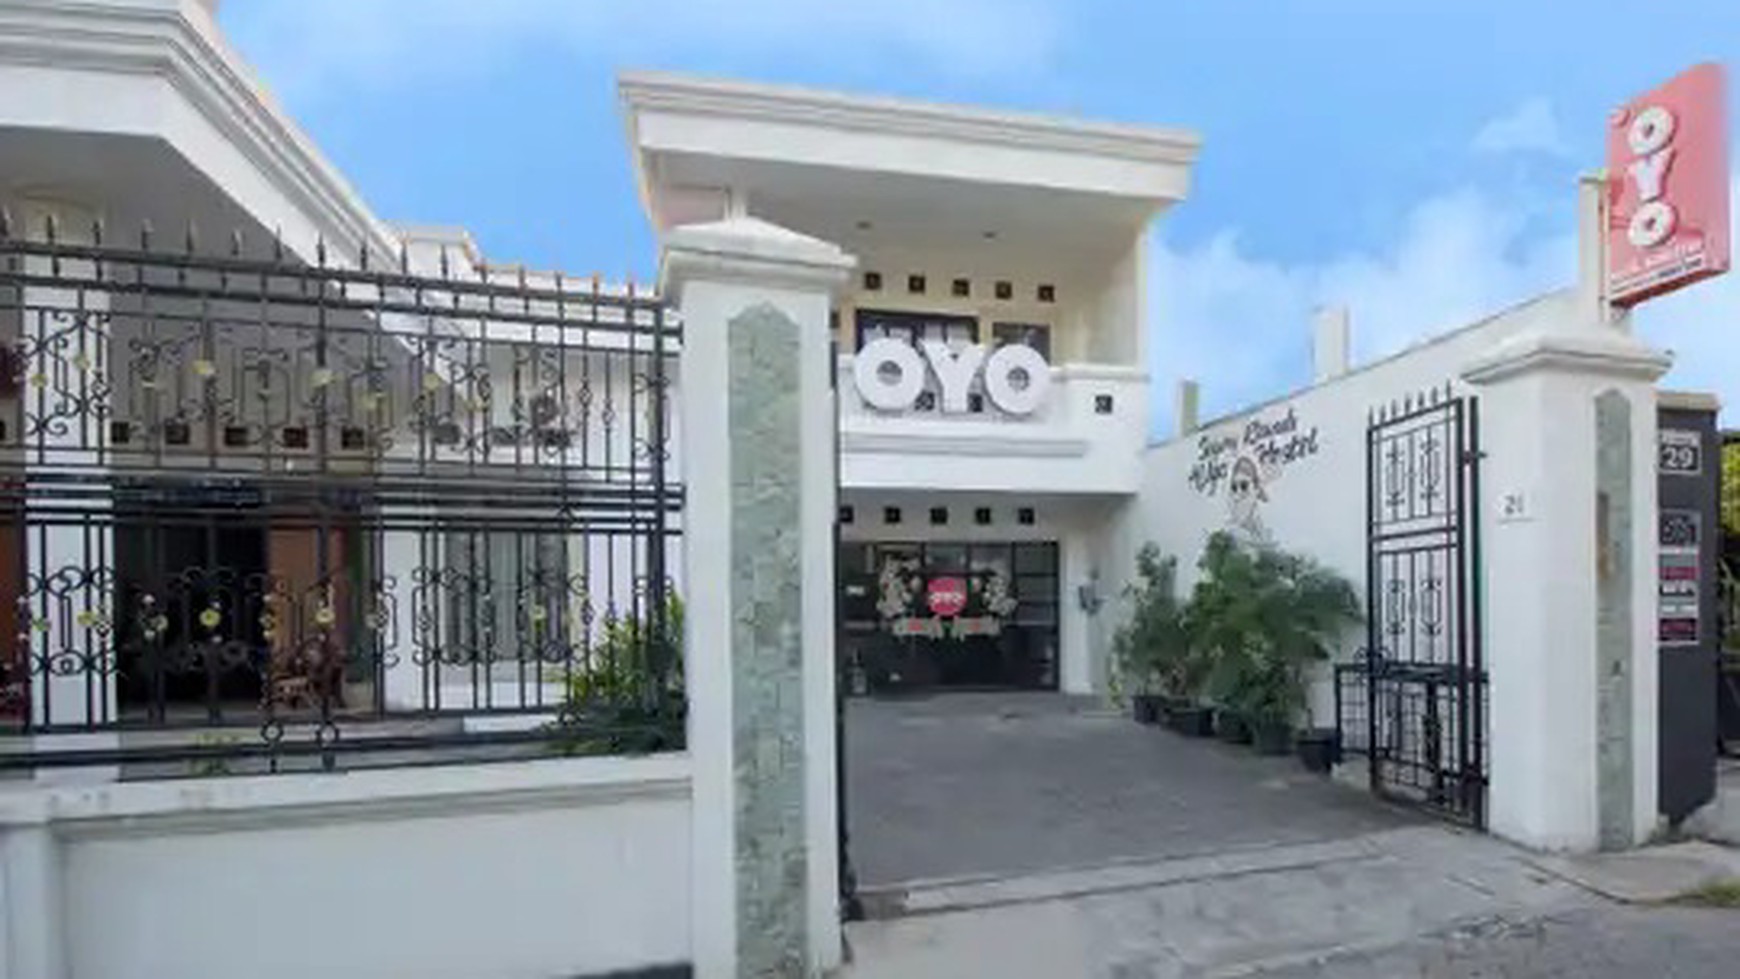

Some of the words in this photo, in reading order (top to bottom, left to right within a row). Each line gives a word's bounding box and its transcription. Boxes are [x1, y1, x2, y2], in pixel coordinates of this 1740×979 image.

[1628, 105, 1675, 247] OYO
[854, 337, 1051, 414] OYO
[1254, 426, 1320, 465] Hostel
[1662, 446, 1694, 469] 29
